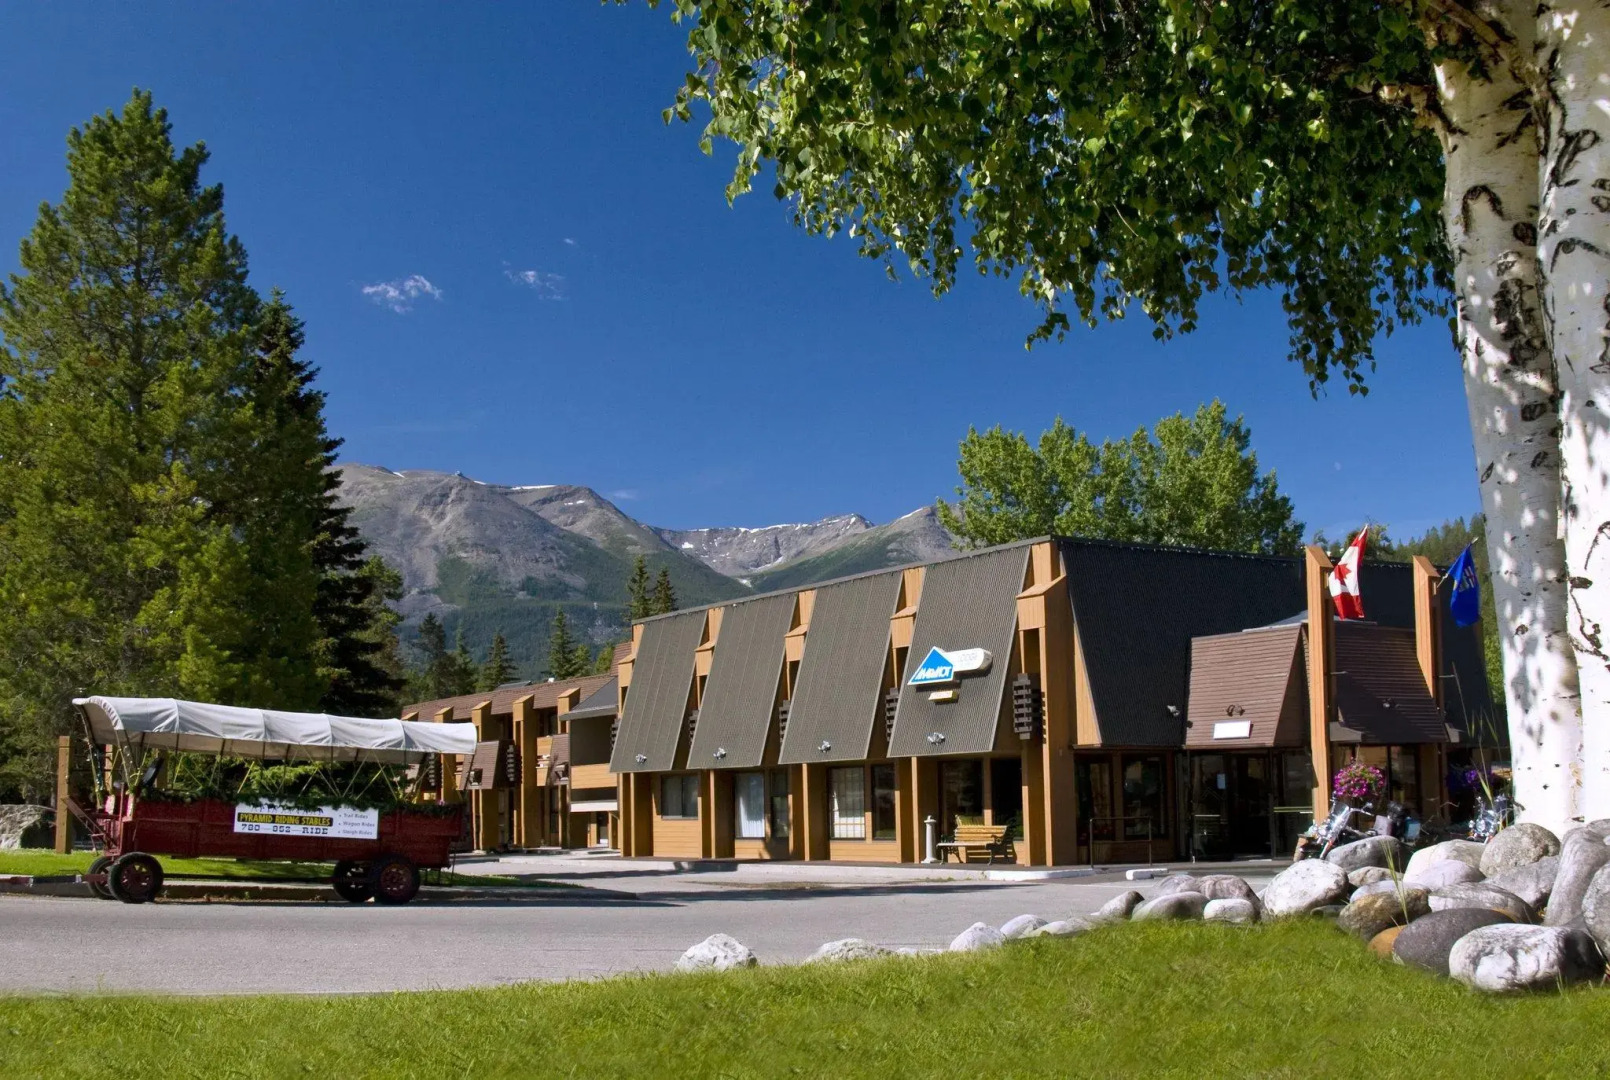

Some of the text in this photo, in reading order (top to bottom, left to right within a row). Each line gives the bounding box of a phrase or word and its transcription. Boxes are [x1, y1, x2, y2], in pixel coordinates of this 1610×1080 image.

[239, 813, 331, 827] PYRAMID RIDING STABLES
